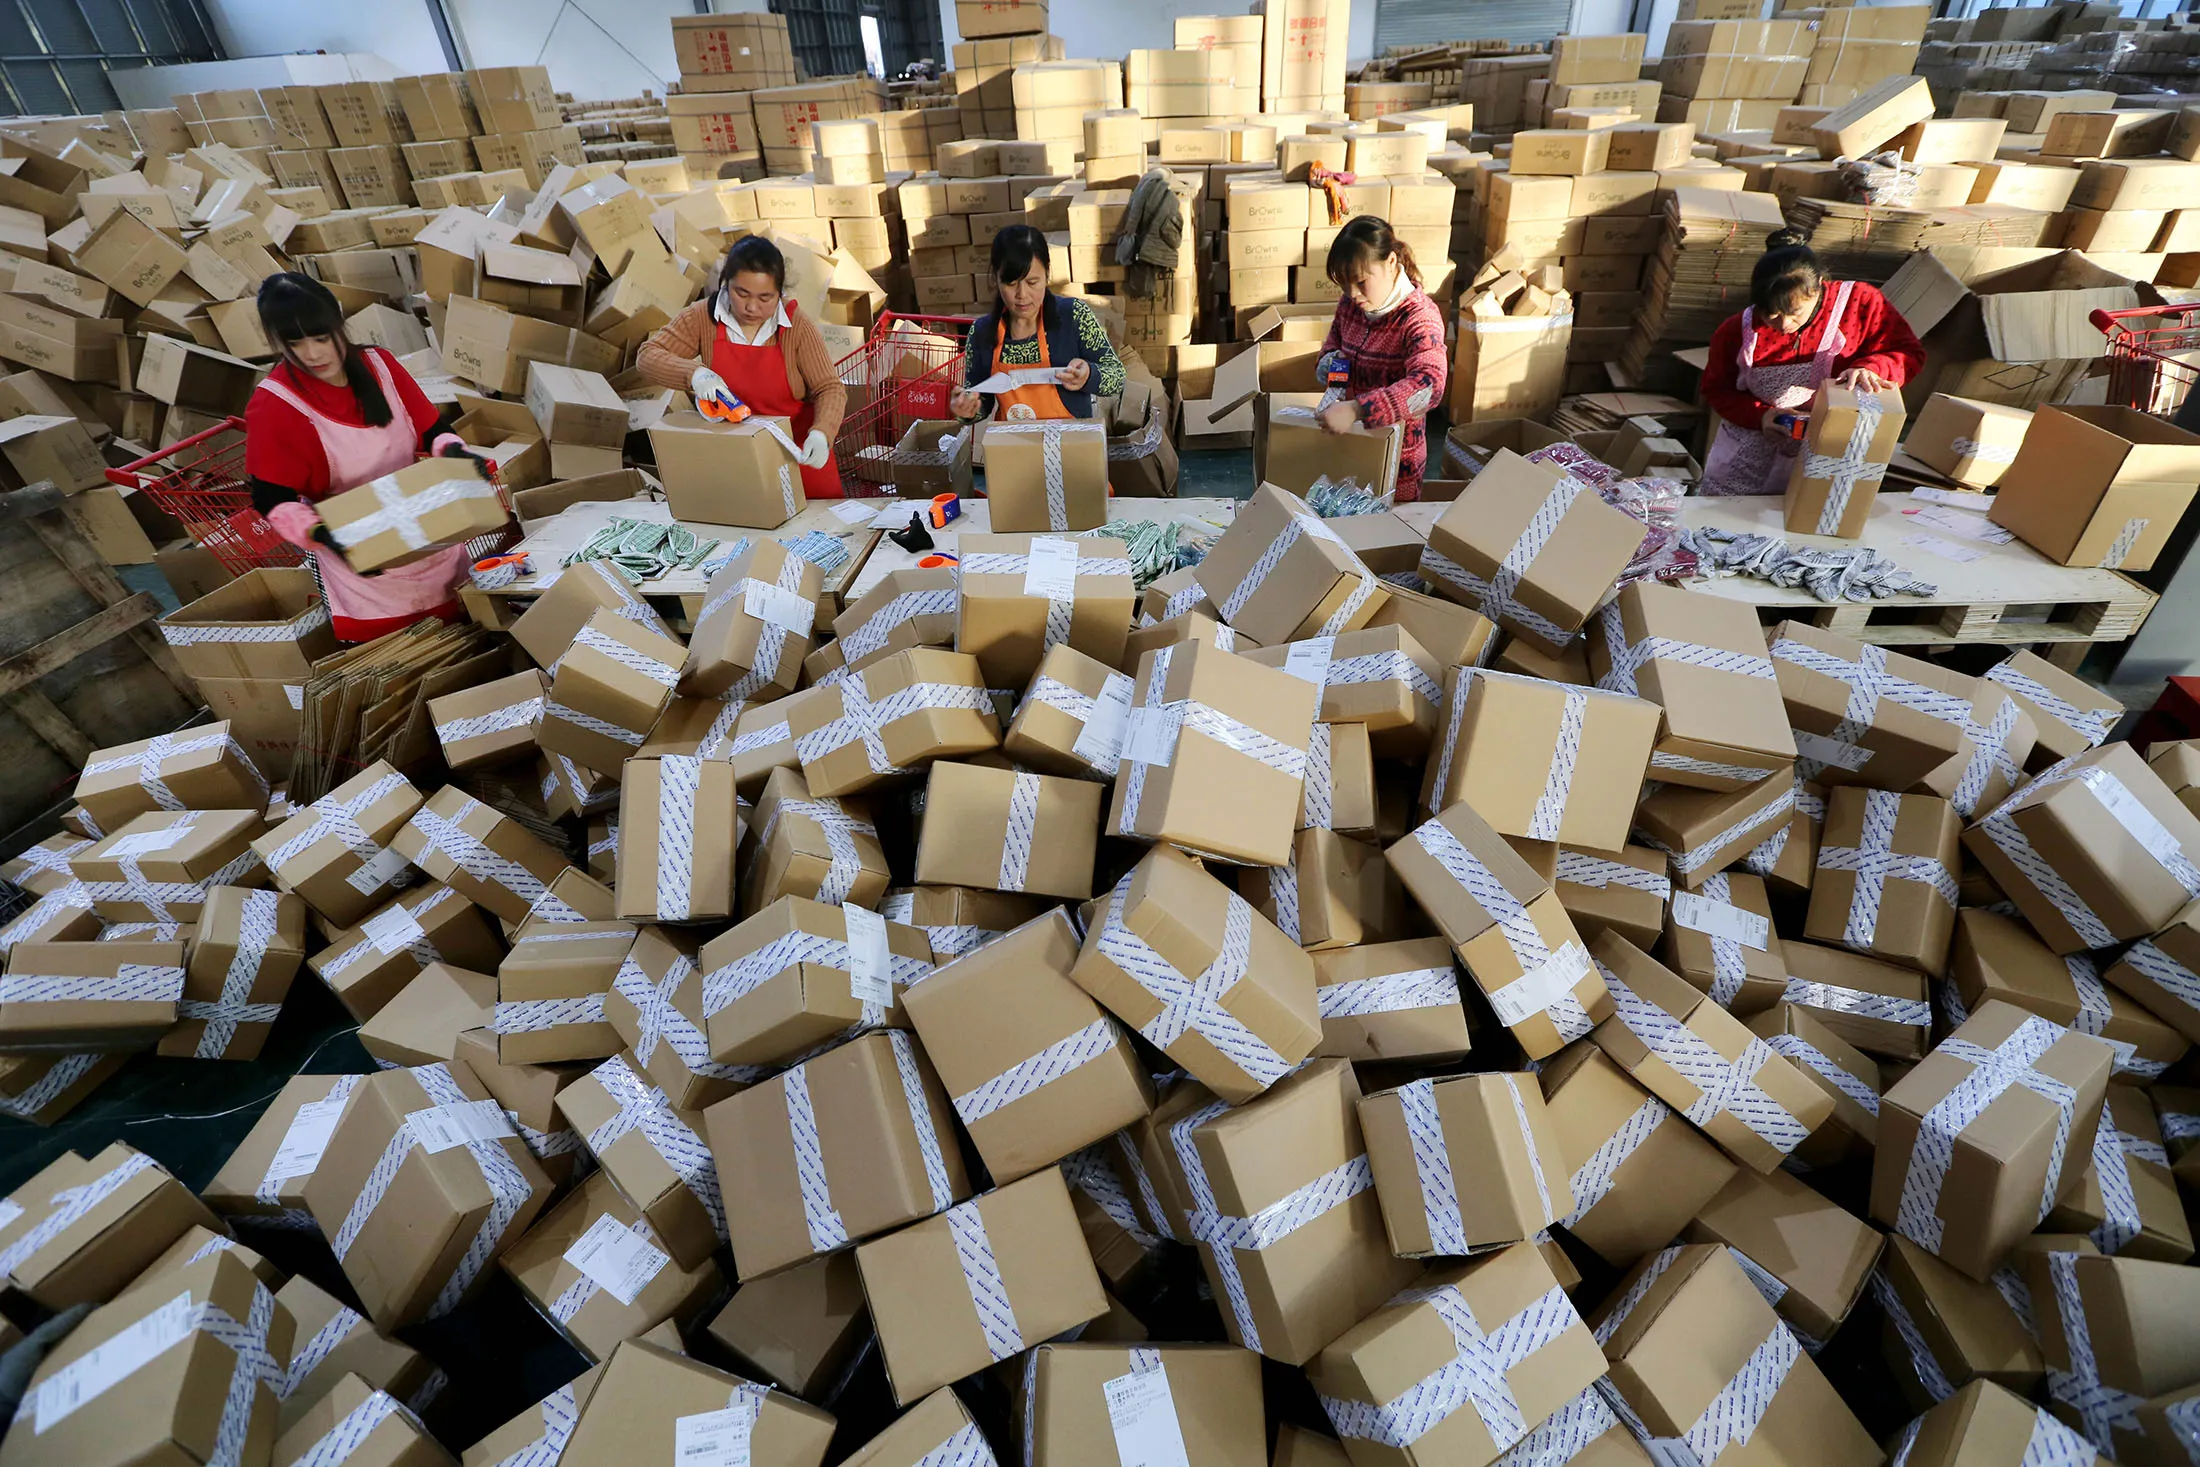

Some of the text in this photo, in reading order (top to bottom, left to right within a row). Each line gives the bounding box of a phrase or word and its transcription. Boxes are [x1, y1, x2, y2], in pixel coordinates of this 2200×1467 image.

[1249, 206, 1284, 216] BrOwns
[1245, 245, 1279, 254] BrOwns
[822, 335, 851, 346] BrOwn
[454, 348, 481, 367] BrOwns
